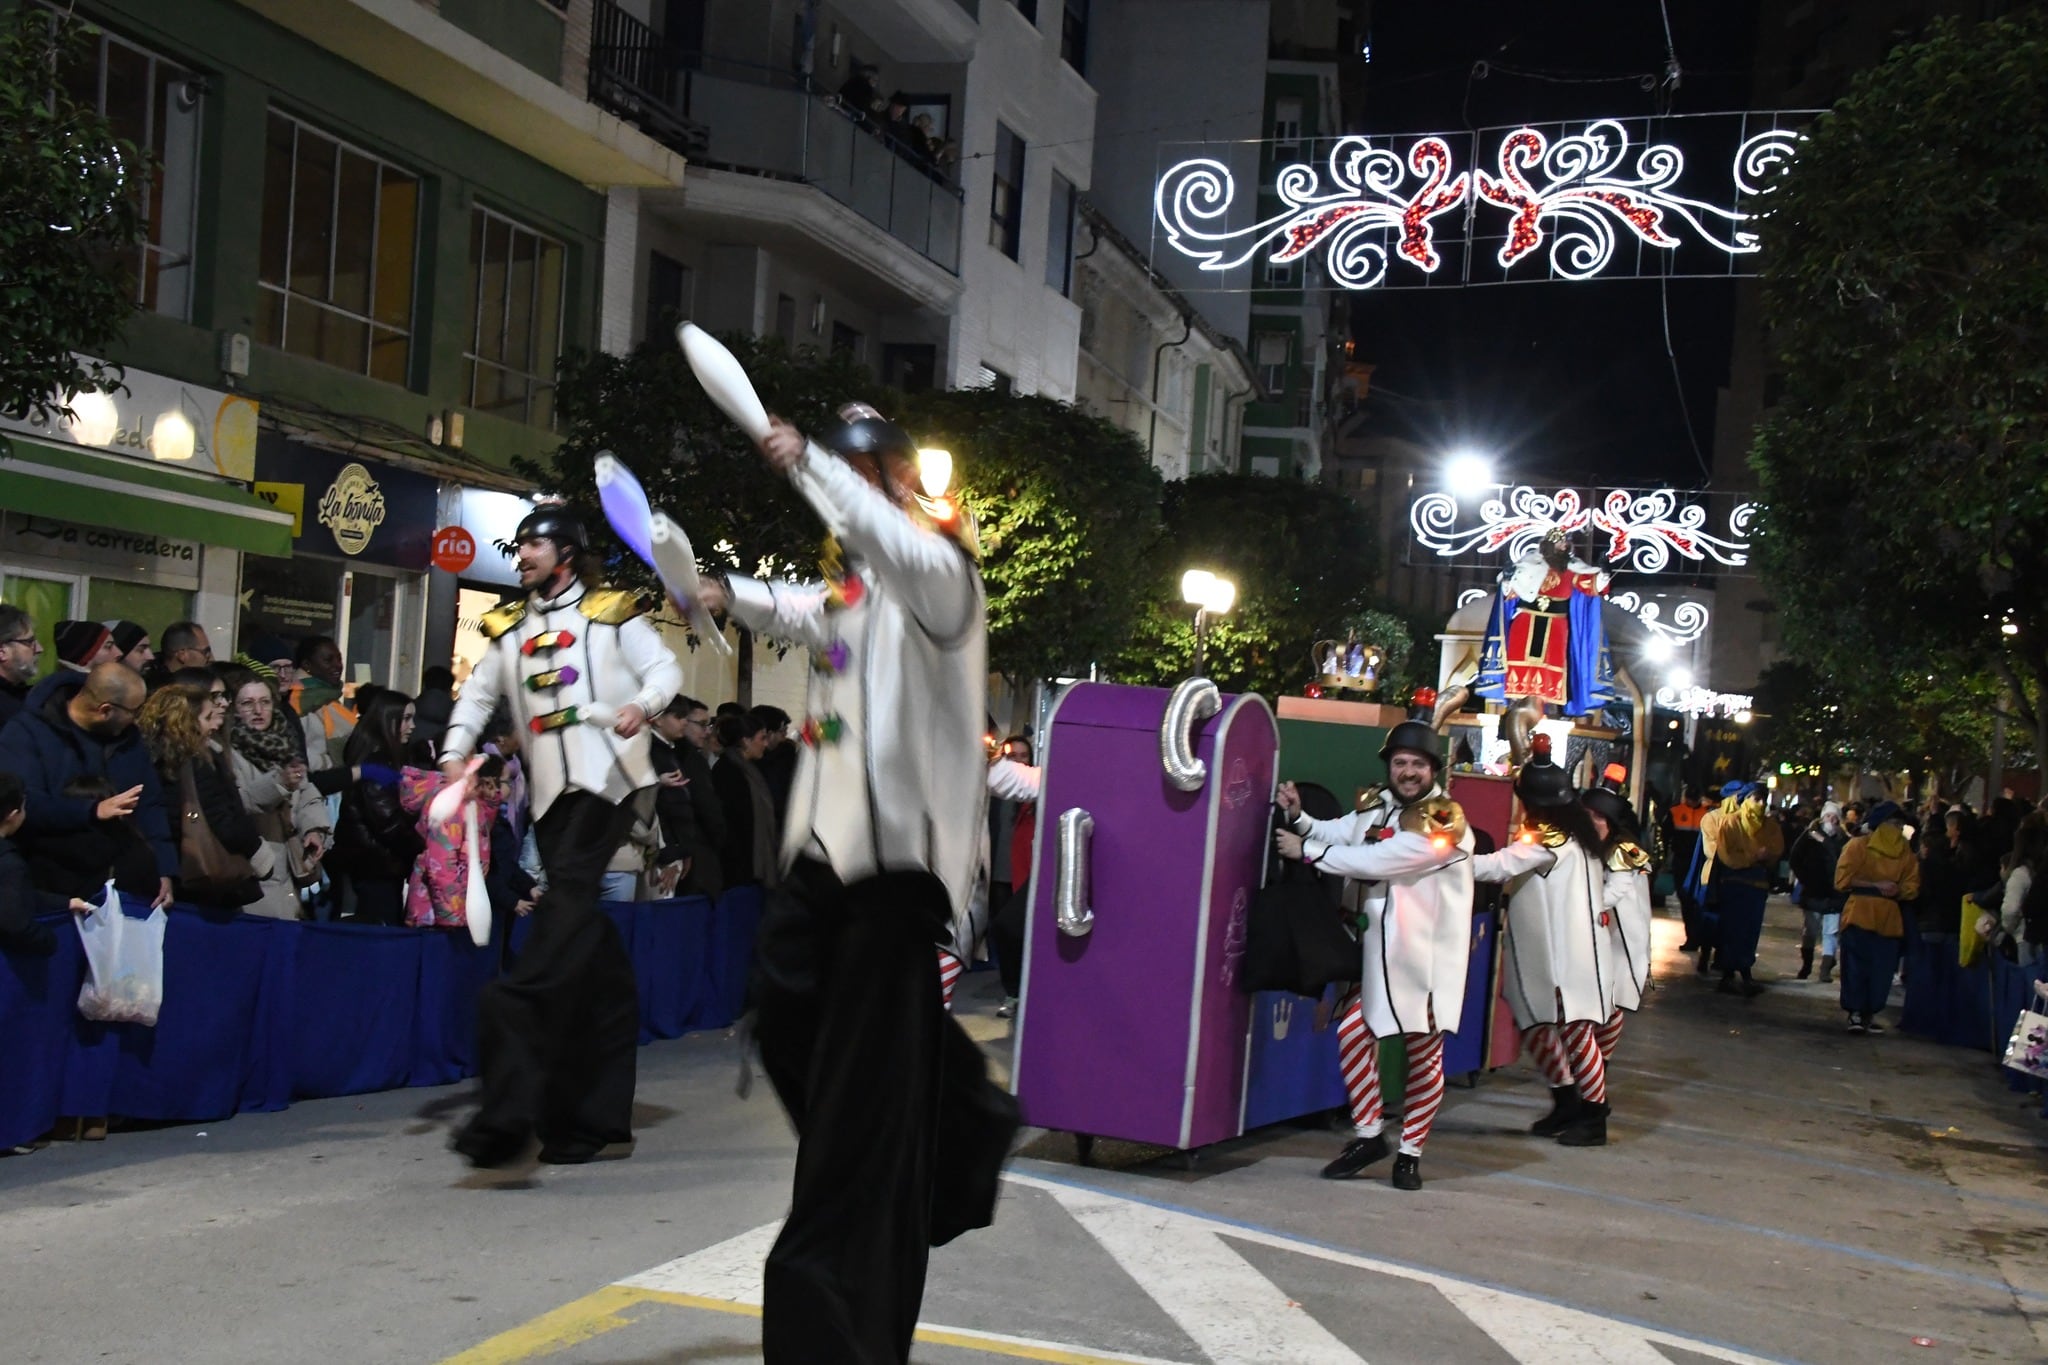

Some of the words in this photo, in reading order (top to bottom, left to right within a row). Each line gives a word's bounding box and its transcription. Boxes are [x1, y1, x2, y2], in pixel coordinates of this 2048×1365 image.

[321, 486, 342, 523] La
[342, 493, 382, 526] bonita
[86, 531, 193, 561] corredera
[438, 531, 471, 556] ria
